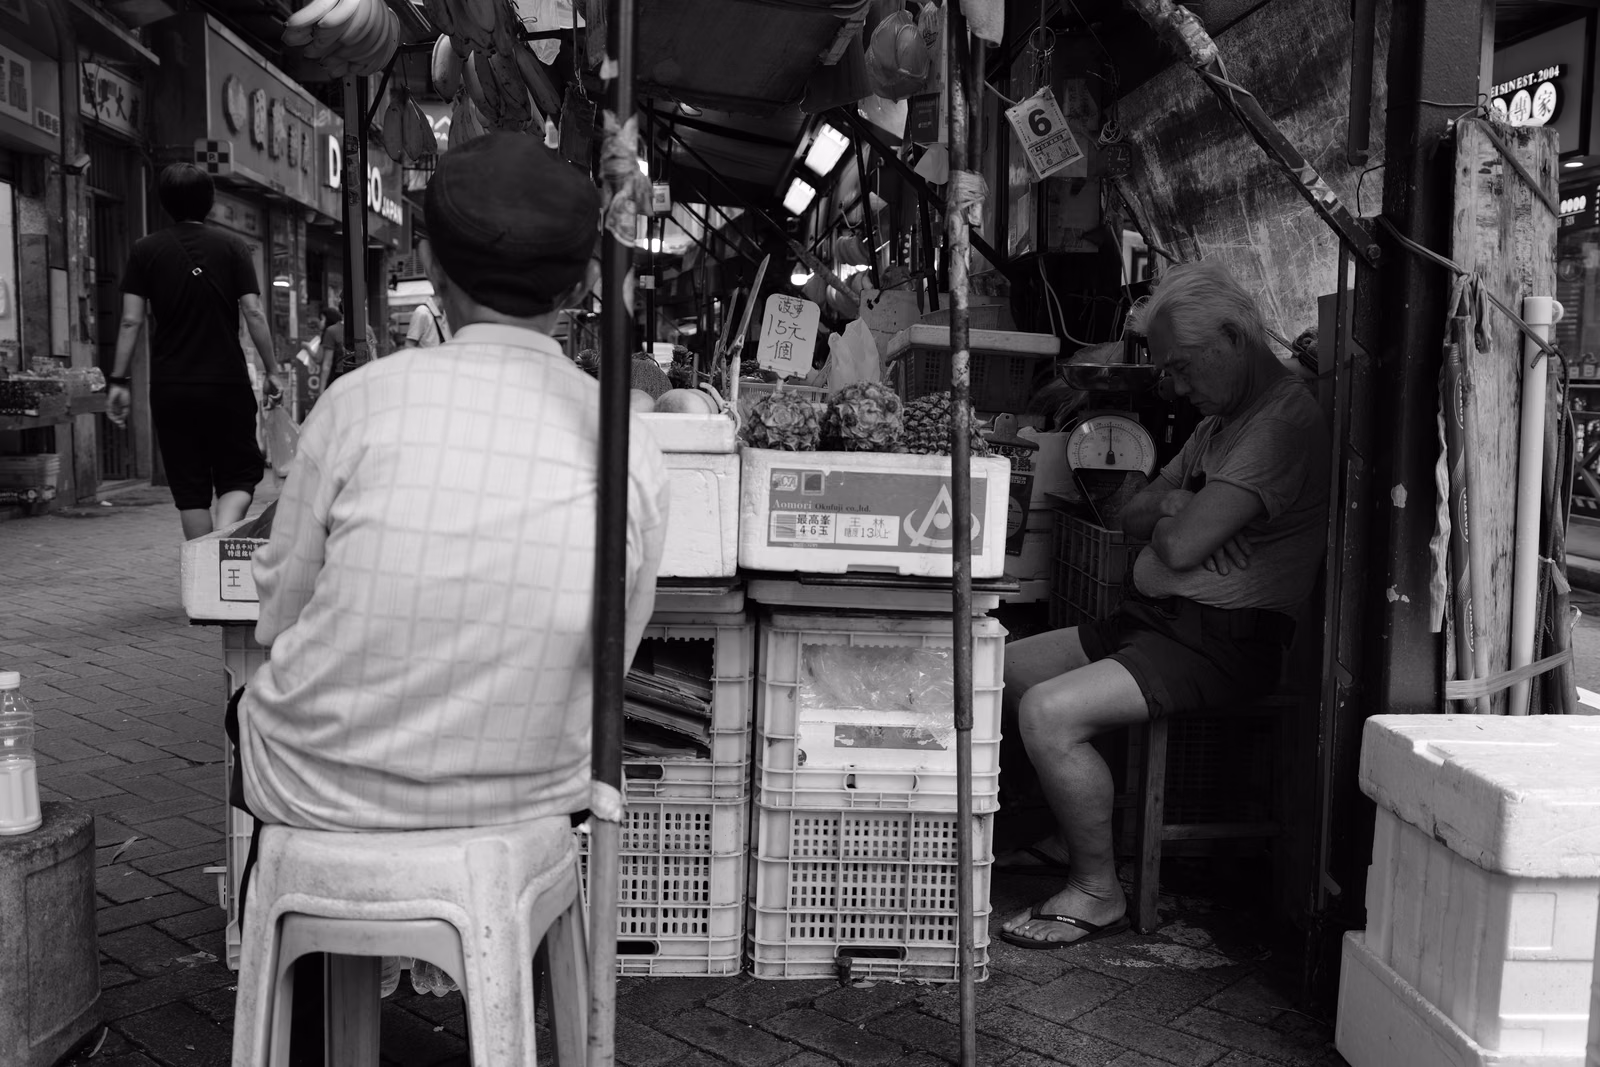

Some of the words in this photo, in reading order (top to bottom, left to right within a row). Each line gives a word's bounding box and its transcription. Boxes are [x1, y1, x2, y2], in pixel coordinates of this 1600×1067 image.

[1028, 108, 1052, 137] 6
[768, 314, 806, 341] 15元
[773, 499, 812, 510] Aomori
[814, 503, 843, 513] Okufuji
[227, 568, 241, 587] 王
